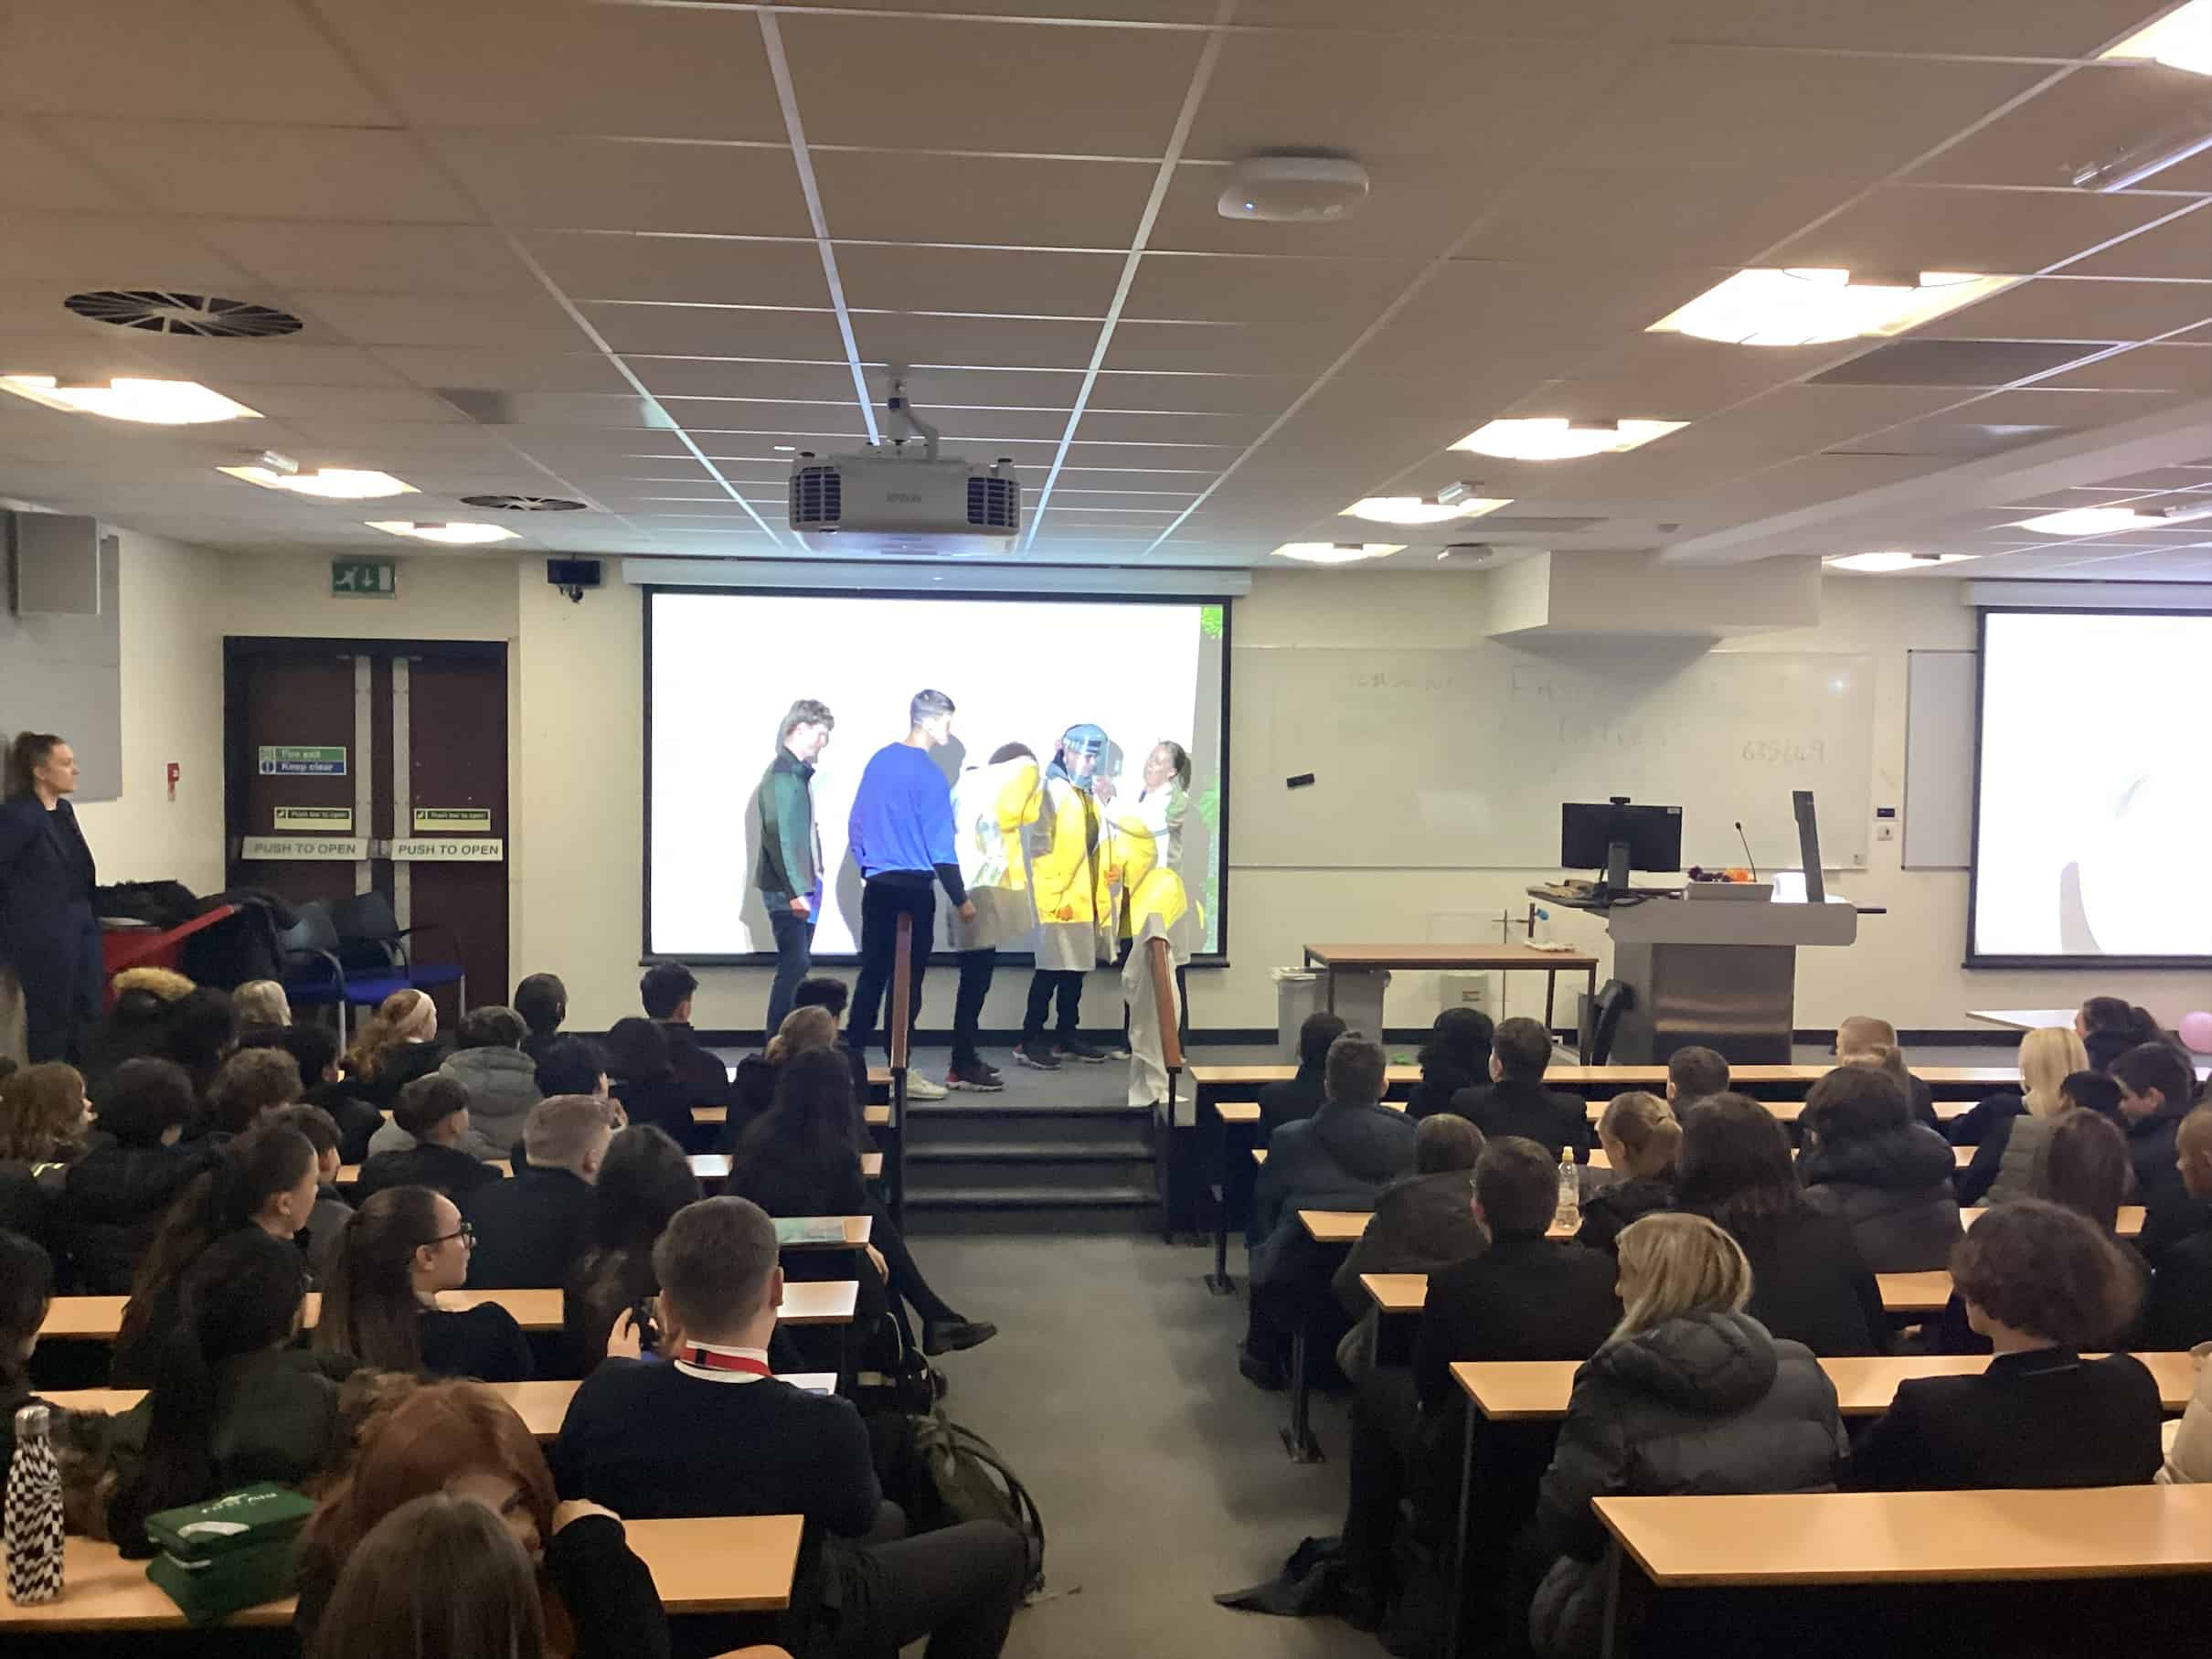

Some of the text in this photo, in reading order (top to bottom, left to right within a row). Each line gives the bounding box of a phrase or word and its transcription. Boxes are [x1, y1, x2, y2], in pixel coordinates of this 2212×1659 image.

[281, 760, 334, 772] Keep clear
[254, 843, 356, 855] PUSH TO OPEN
[398, 845, 499, 856] PUSH TO OPEN
